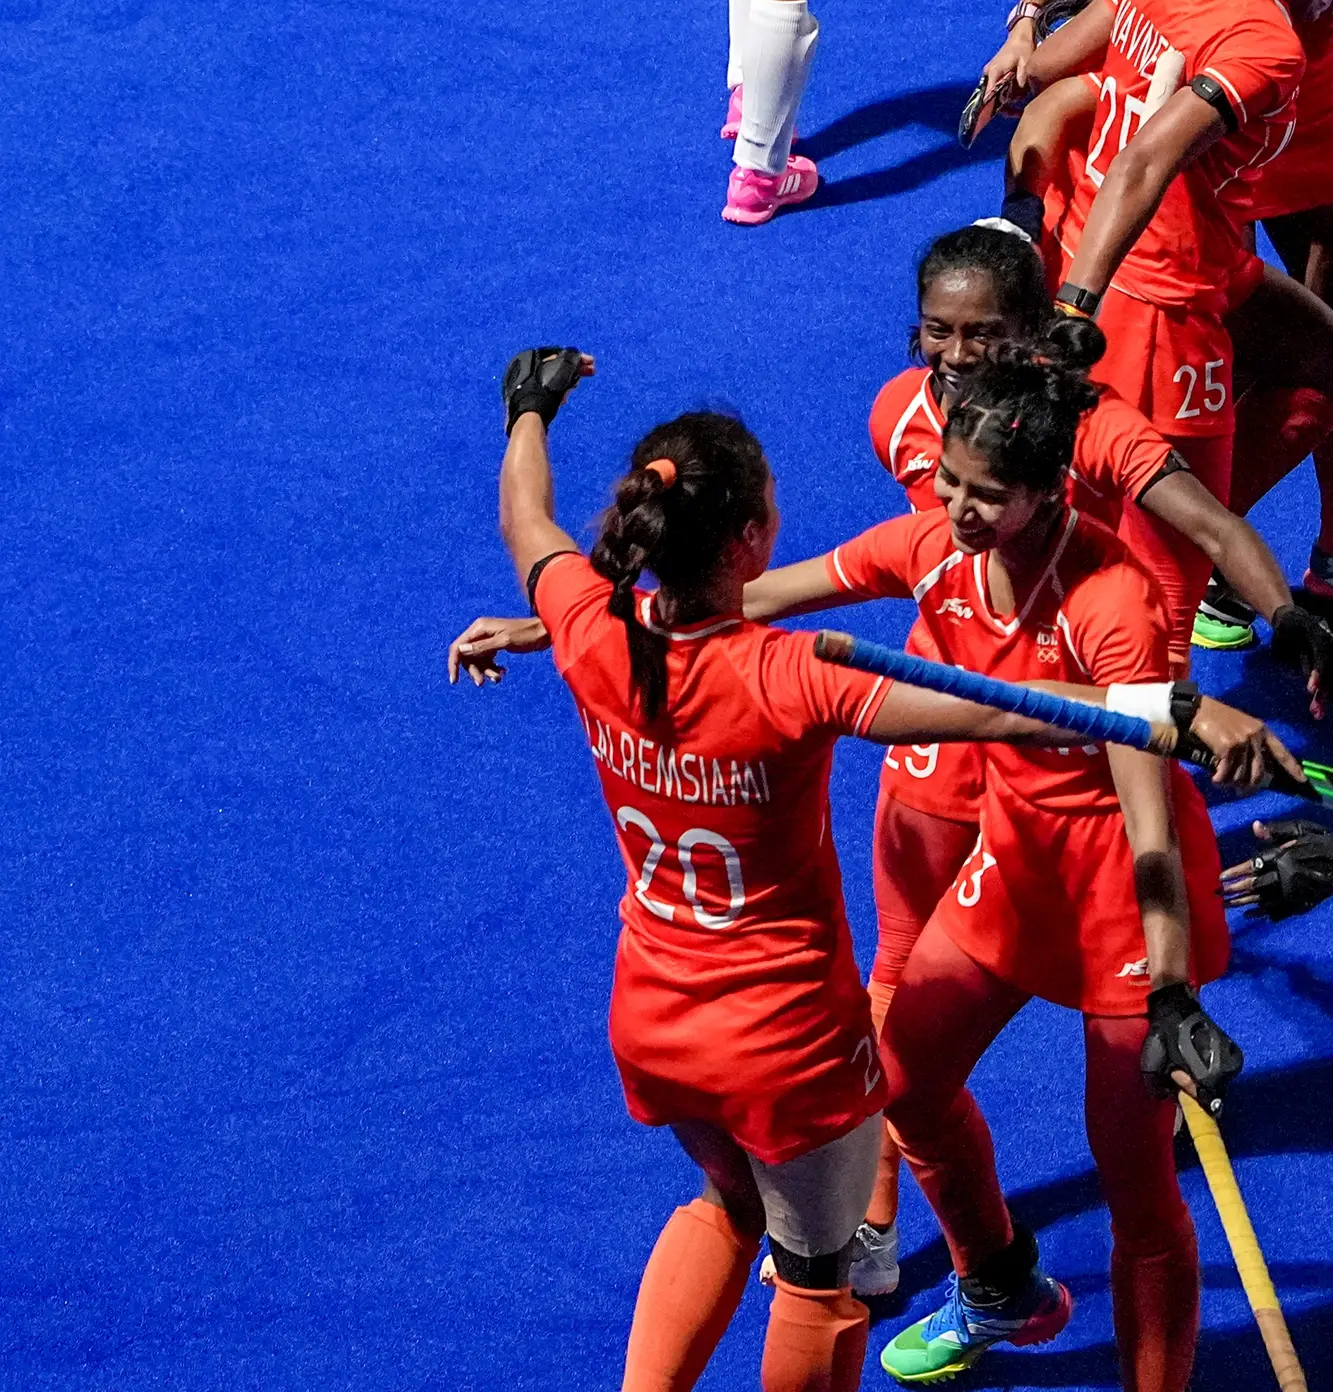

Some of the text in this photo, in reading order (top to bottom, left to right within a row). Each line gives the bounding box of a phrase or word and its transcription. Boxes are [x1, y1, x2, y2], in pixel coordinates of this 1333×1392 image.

[1173, 358, 1227, 420] 25
[582, 707, 771, 806] LALREMSIAMI
[616, 805, 747, 932] 20
[1114, 957, 1149, 978] JS
